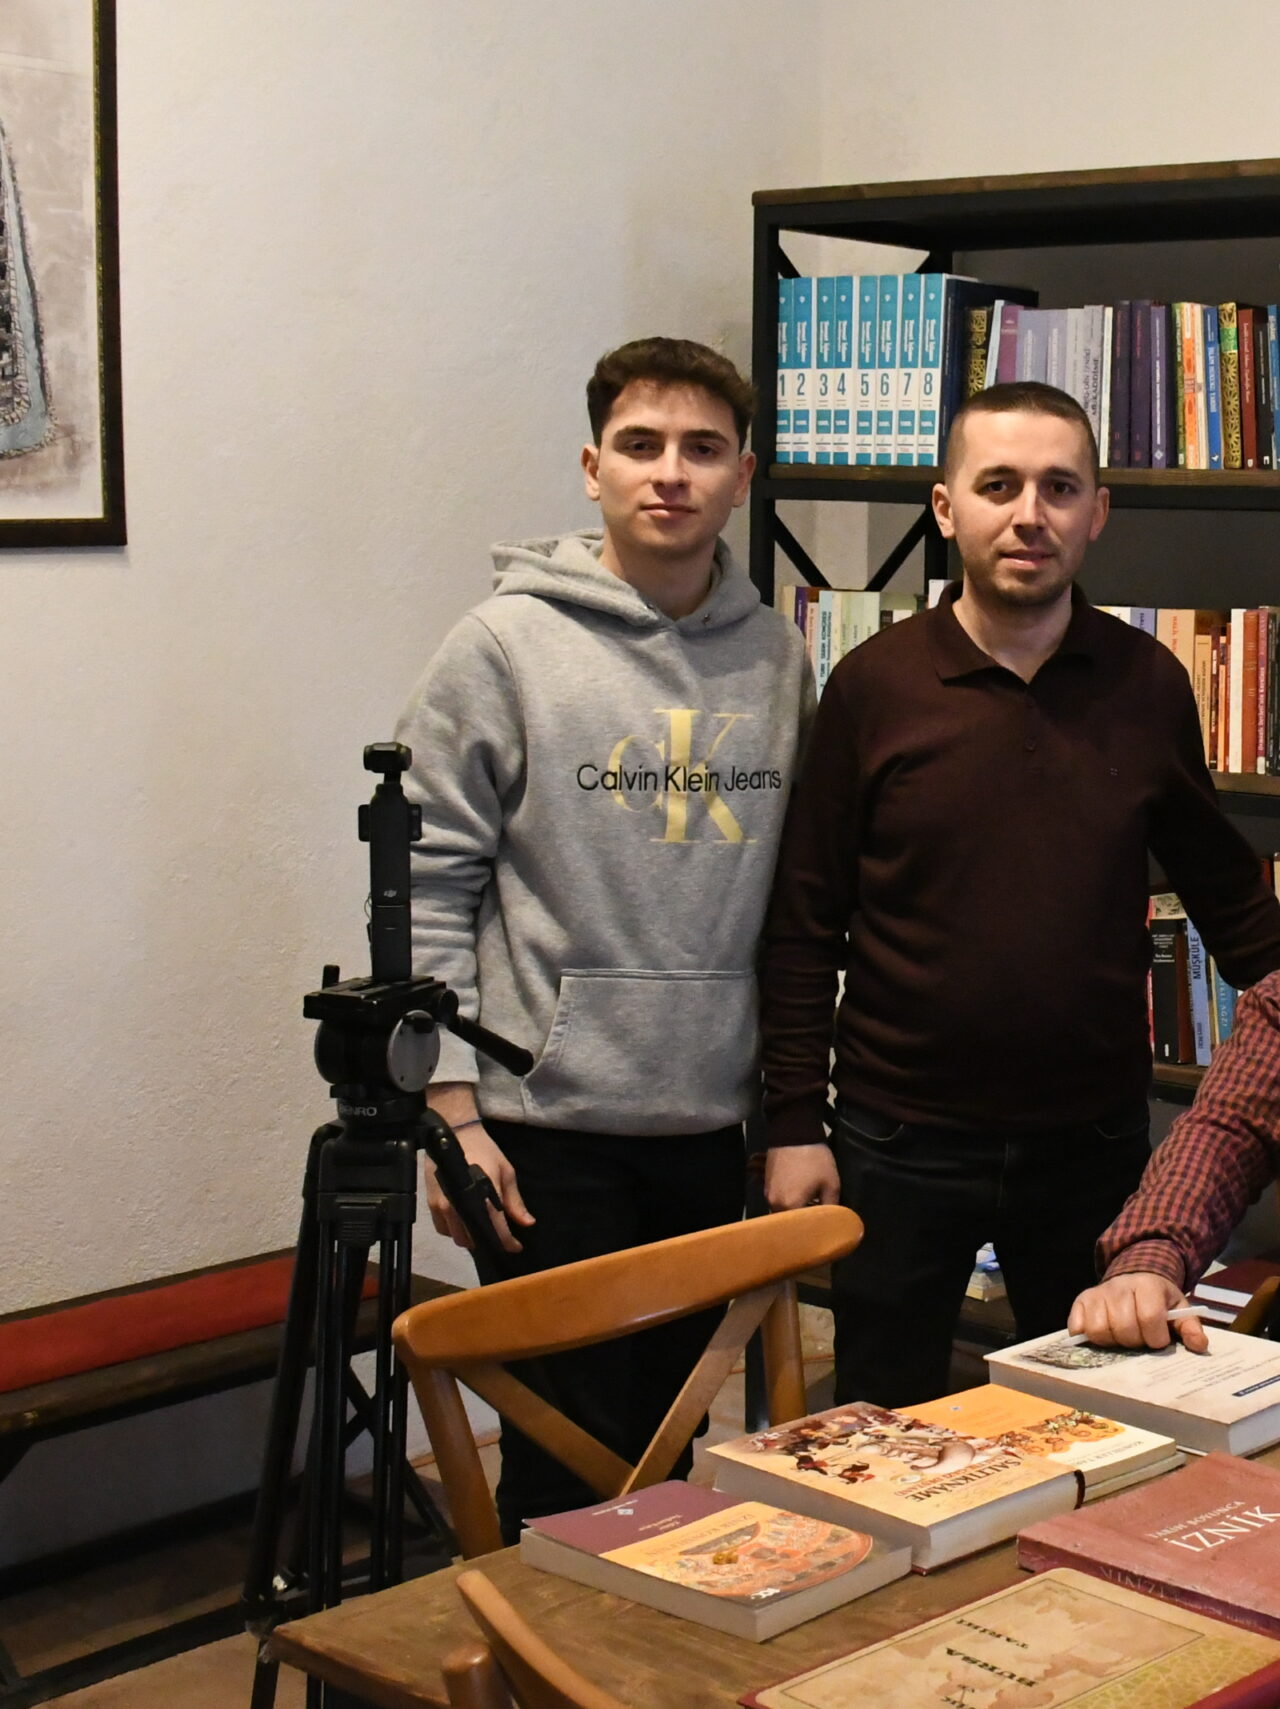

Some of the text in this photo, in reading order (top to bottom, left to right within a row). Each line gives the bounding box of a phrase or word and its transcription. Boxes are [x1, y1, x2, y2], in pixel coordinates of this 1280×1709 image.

[796, 373, 805, 396] 2
[819, 373, 828, 396] 3
[837, 373, 847, 396] 4
[860, 373, 869, 396] 5
[880, 373, 890, 396] 6
[904, 373, 911, 396] 7
[923, 373, 933, 396] 8
[577, 764, 782, 792] Calvin Klein Jeans
[1187, 1500, 1245, 1526] BOYUNCA
[945, 1648, 1038, 1687] BURSA
